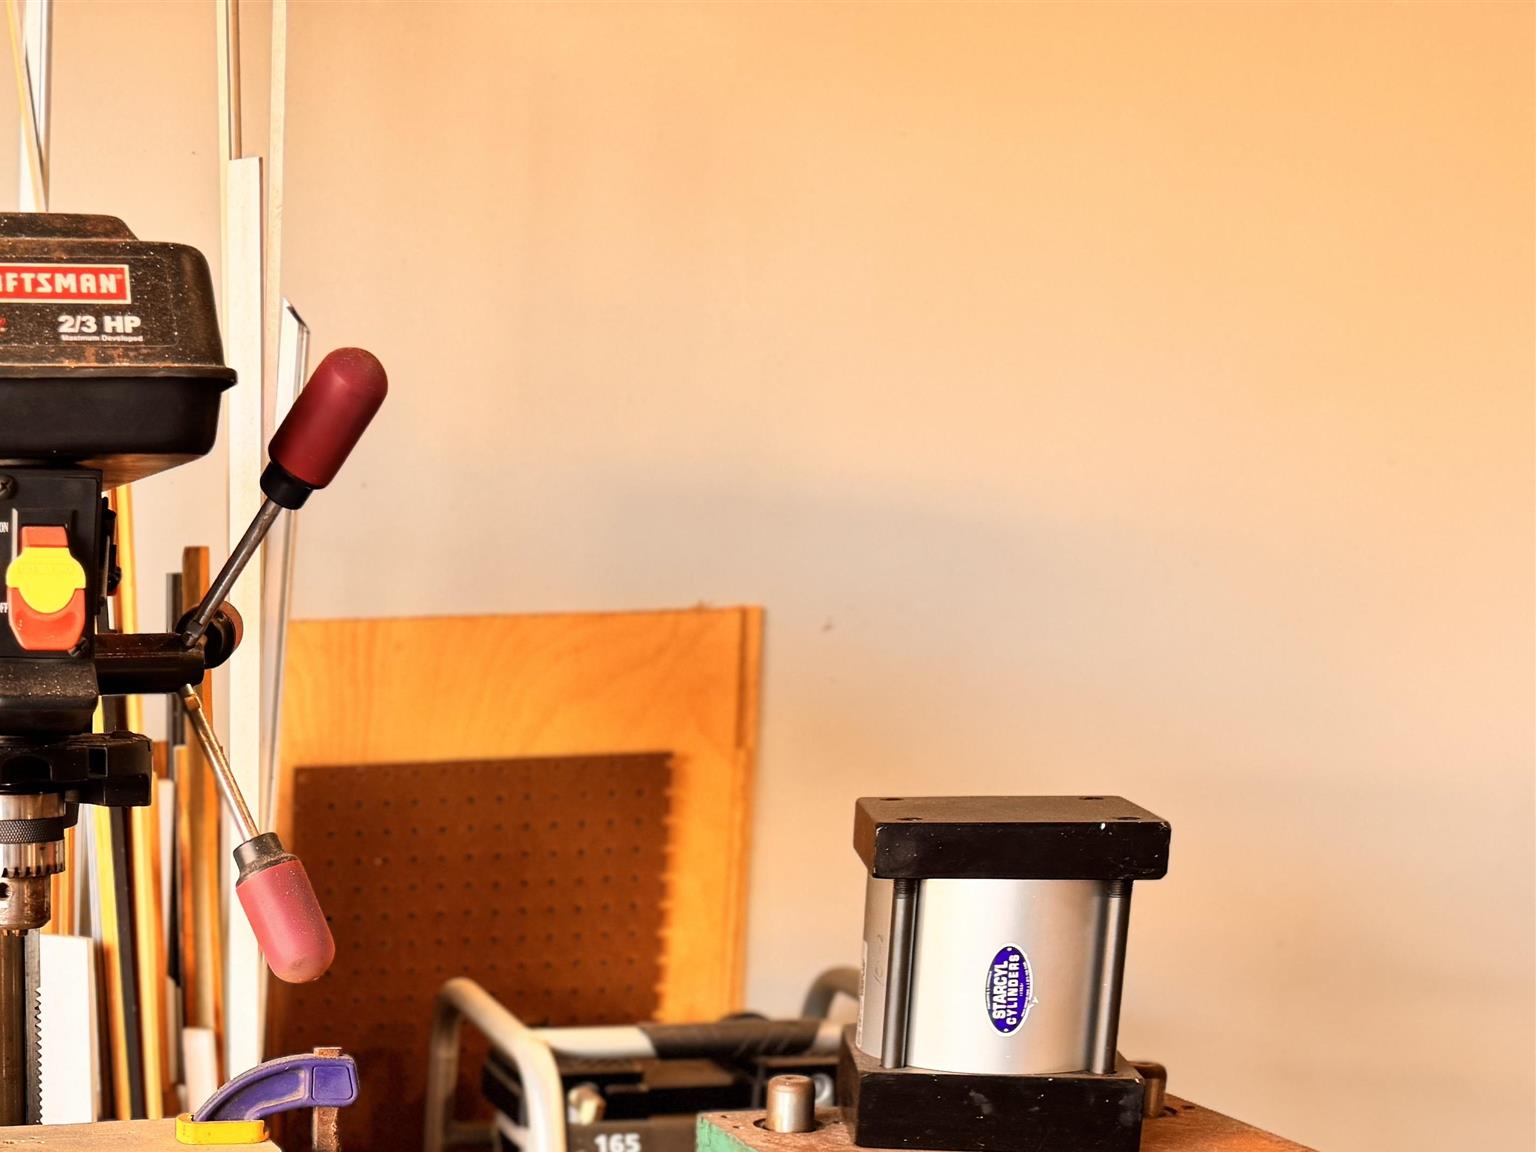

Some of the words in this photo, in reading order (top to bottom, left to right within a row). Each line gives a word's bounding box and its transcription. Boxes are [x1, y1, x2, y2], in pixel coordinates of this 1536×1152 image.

[57, 315, 97, 333] 2/3
[104, 316, 141, 333] HP
[992, 961, 1008, 1019] STARCYL
[1006, 955, 1020, 1025] CYLINDERS
